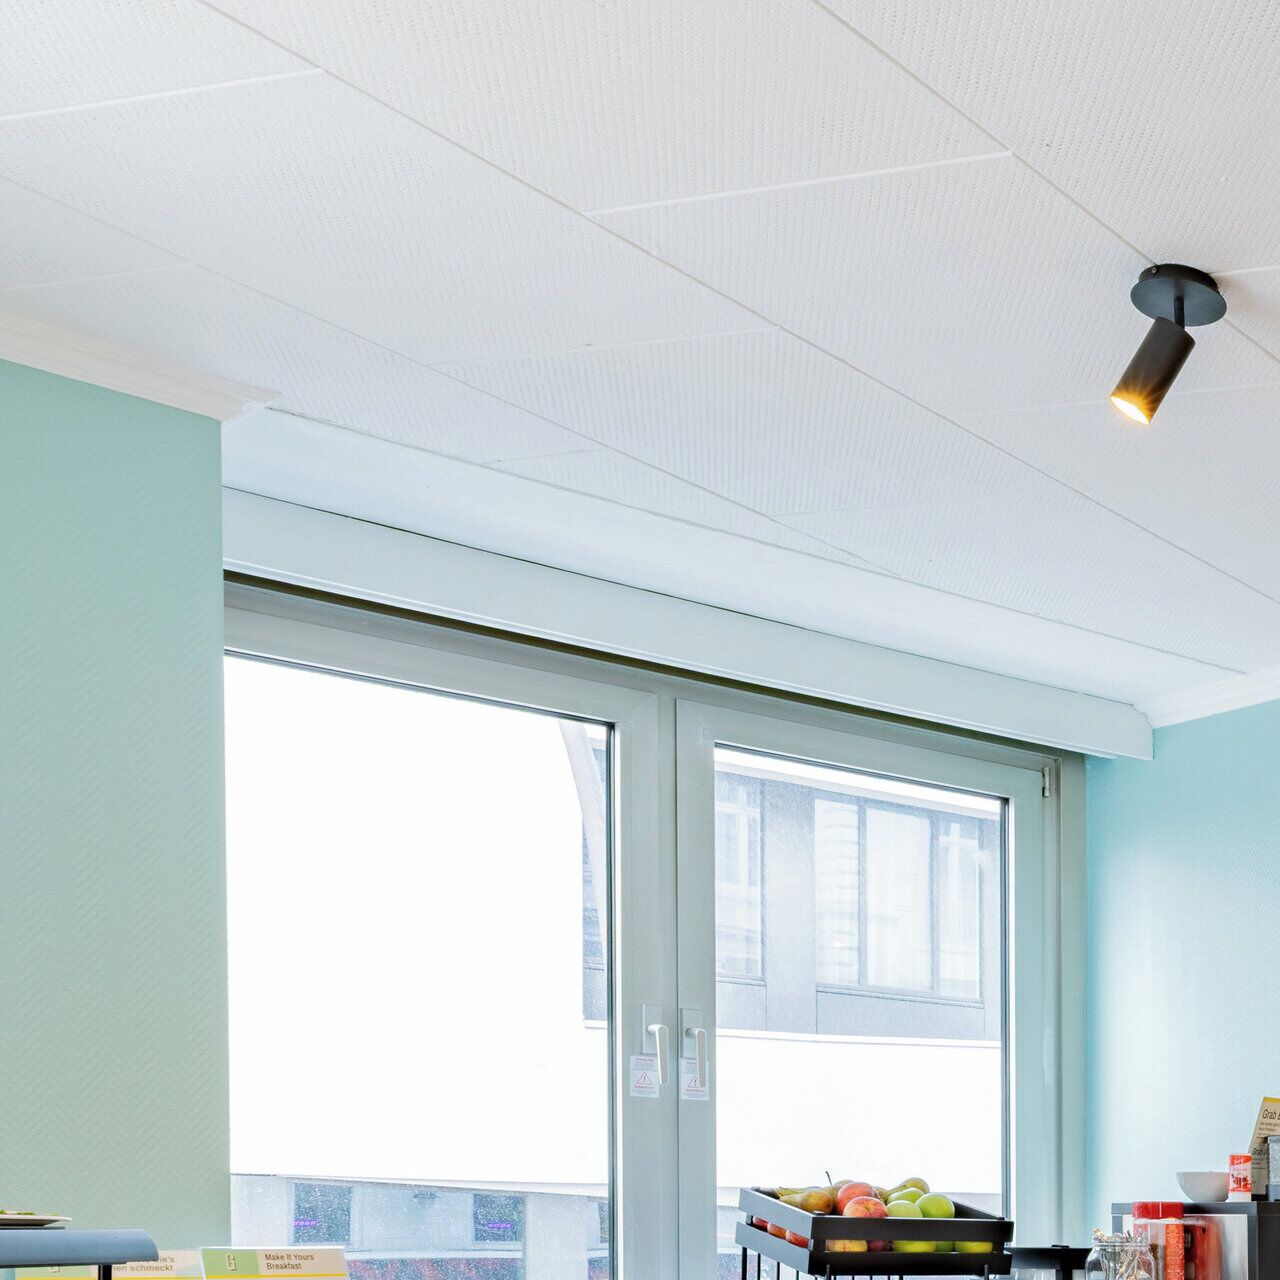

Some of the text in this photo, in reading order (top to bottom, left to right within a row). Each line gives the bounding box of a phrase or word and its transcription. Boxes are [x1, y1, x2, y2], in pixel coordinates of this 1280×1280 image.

[1262, 1108, 1277, 1121] Grab
[264, 1253, 285, 1261] Make
[293, 1253, 314, 1261] Yours
[130, 1264, 173, 1272] schmeckt
[267, 1262, 302, 1270] Breakfast
